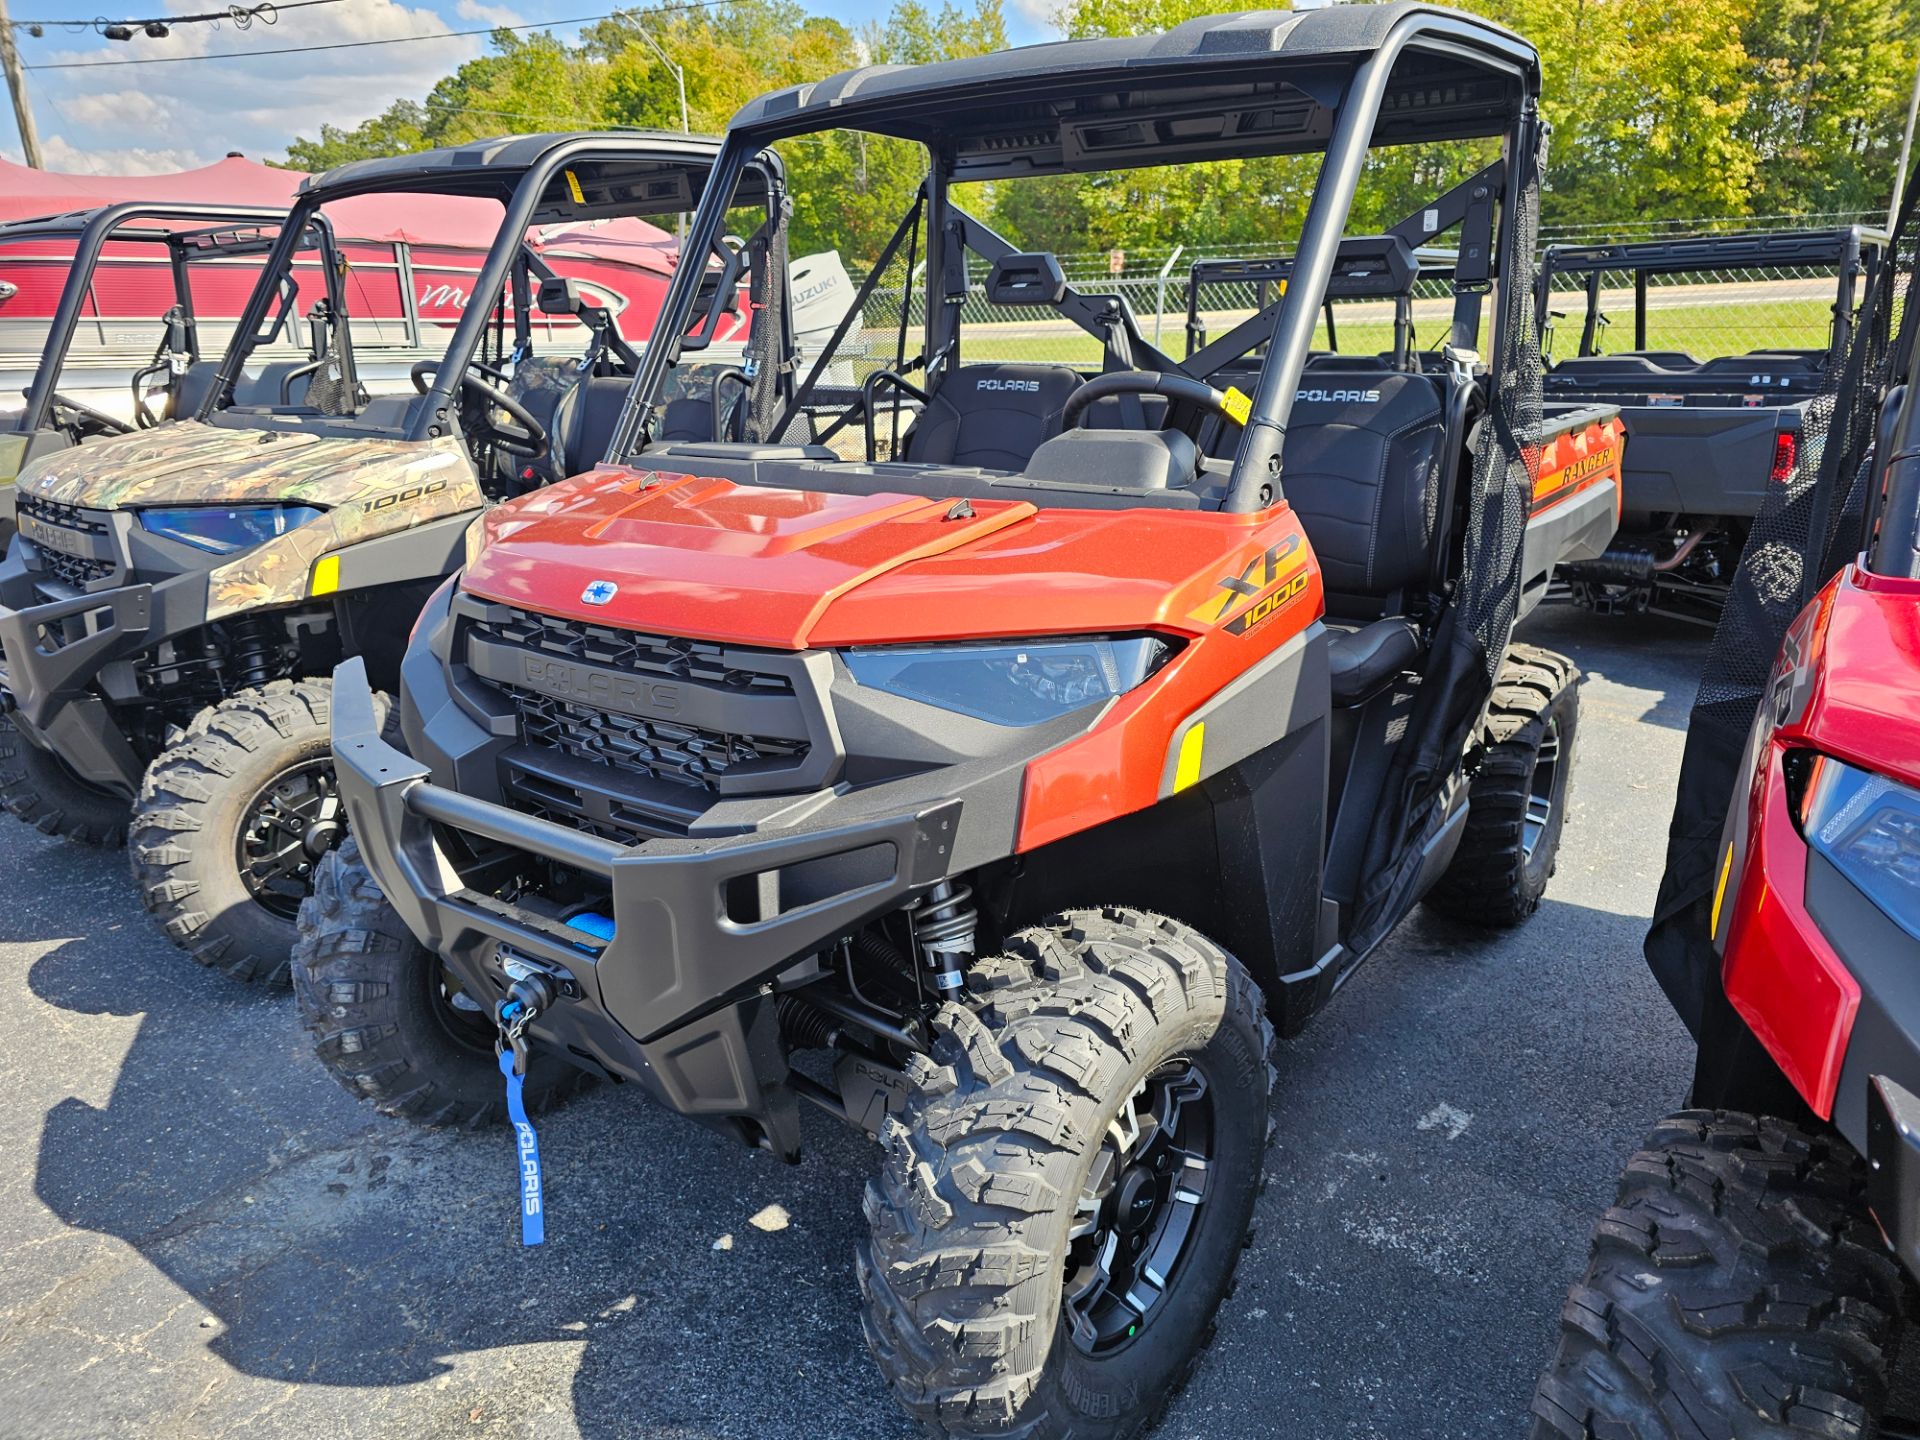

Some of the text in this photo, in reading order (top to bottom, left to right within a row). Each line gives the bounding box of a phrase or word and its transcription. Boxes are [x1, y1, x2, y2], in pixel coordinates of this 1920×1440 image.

[976, 379, 1040, 392] POLARIS
[1294, 390, 1380, 402] POLARIS
[1562, 448, 1610, 486] RANGER
[363, 479, 448, 513] 1000
[1215, 533, 1301, 621] XP
[1244, 571, 1309, 629] 1000
[524, 655, 682, 717] POLARIS
[855, 1062, 909, 1094] POLA
[515, 1121, 540, 1216] POLARIS
